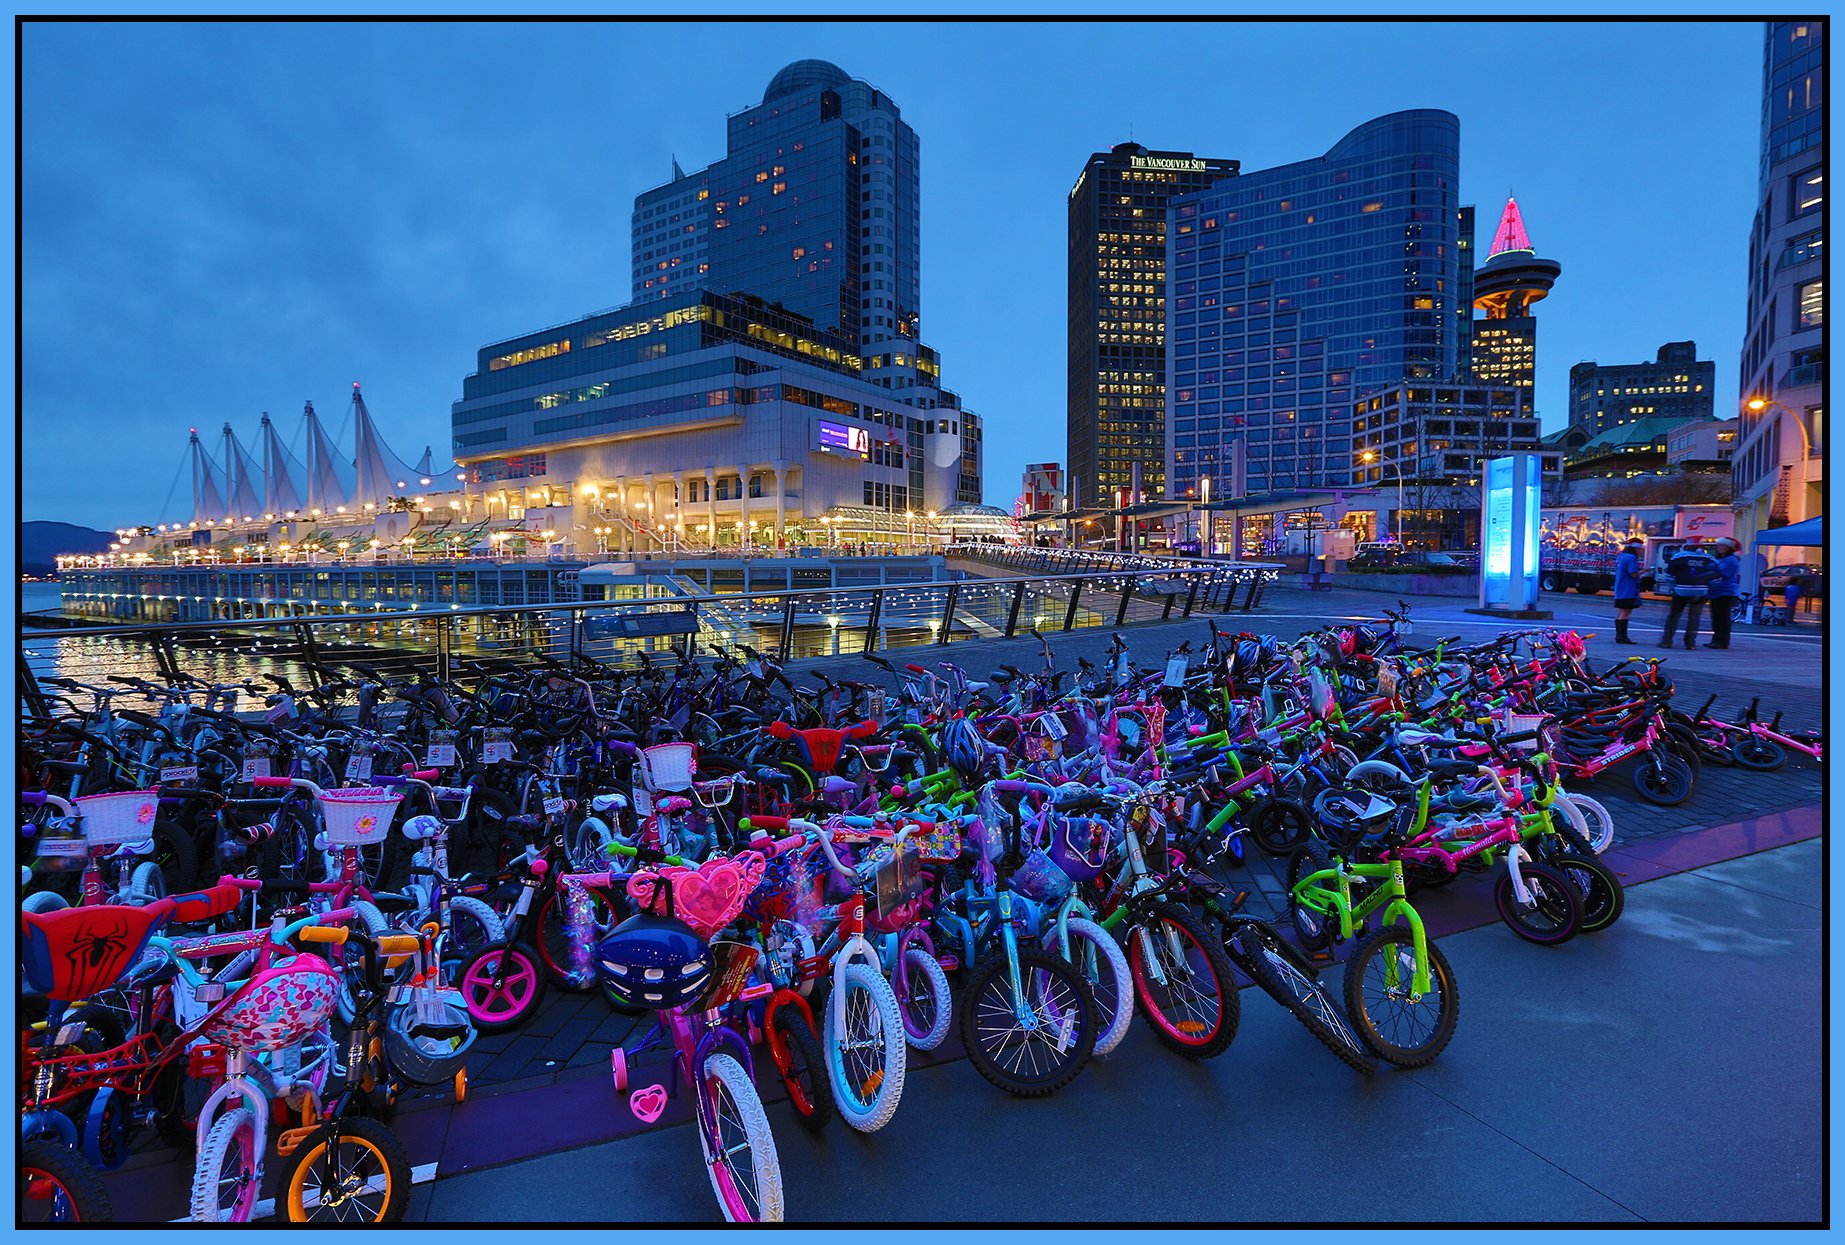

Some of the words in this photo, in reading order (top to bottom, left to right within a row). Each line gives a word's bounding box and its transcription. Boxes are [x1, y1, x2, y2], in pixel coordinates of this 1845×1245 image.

[1130, 155, 1146, 167] THE
[1147, 156, 1190, 171] VANCOUVER
[1191, 159, 1206, 170] SUN
[247, 532, 264, 544] PLACE
[1601, 744, 1636, 766] STRIDER
[1462, 835, 1495, 857] Mermaid
[1360, 886, 1384, 911] MACHO
